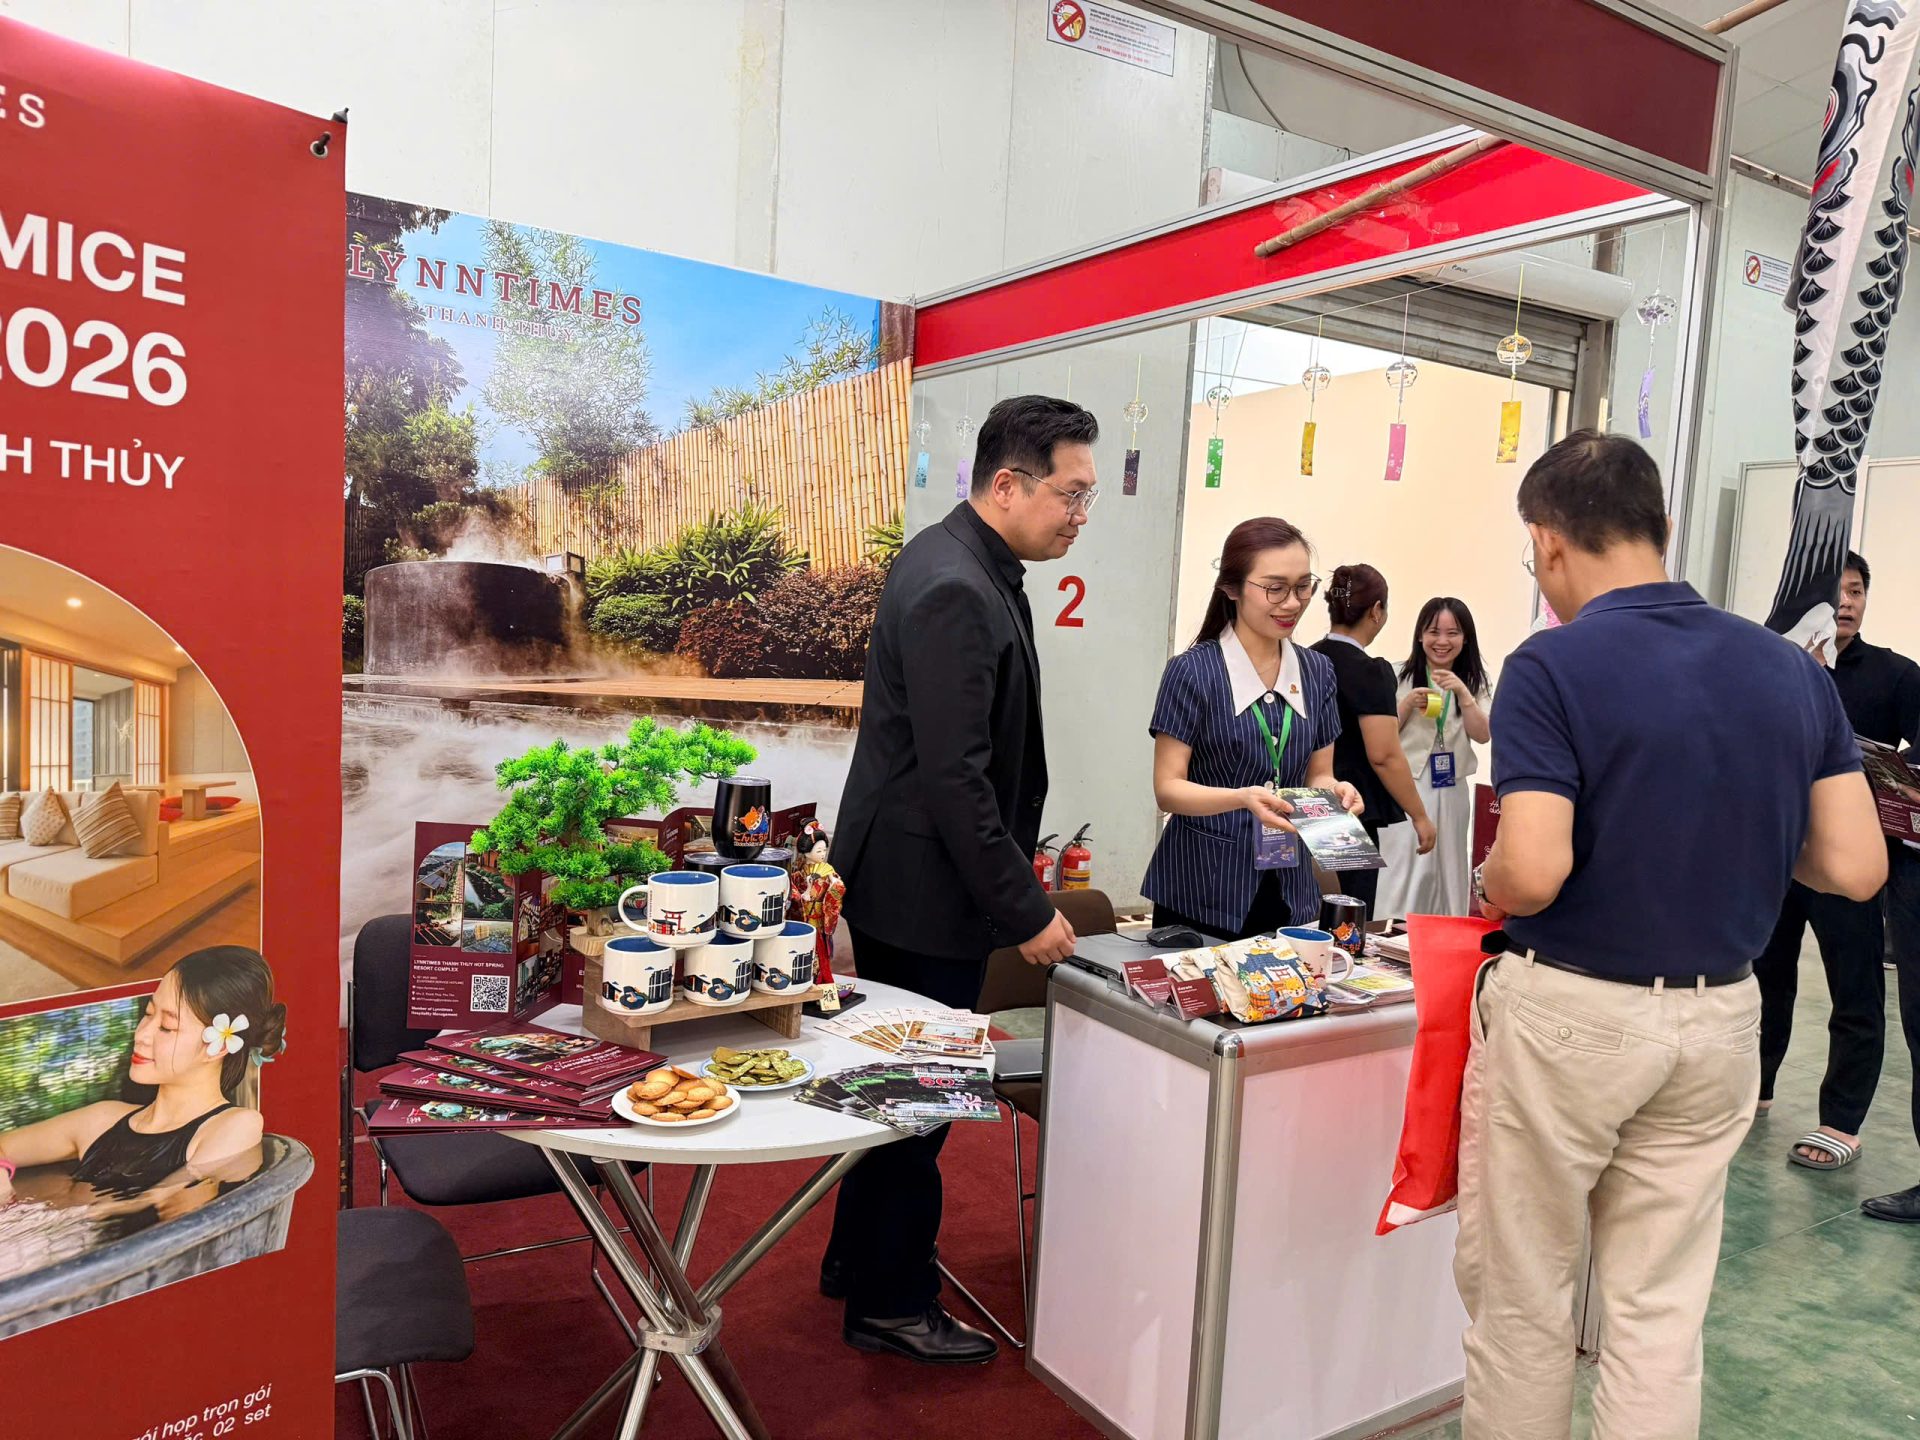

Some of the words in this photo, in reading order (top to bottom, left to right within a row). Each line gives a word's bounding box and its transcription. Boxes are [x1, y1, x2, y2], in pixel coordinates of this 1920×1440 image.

[0, 211, 186, 306] MICE
[349, 244, 643, 325] LYNNTIMES
[425, 305, 505, 331] THANH
[0, 307, 187, 407] 026
[50, 438, 185, 489] THỦY
[1055, 575, 1085, 628] 2
[162, 1414, 197, 1439] họp
[203, 1398, 239, 1420] trọn
[243, 1383, 272, 1409] gói
[213, 1416, 235, 1437] 02
[244, 1403, 272, 1425] set
